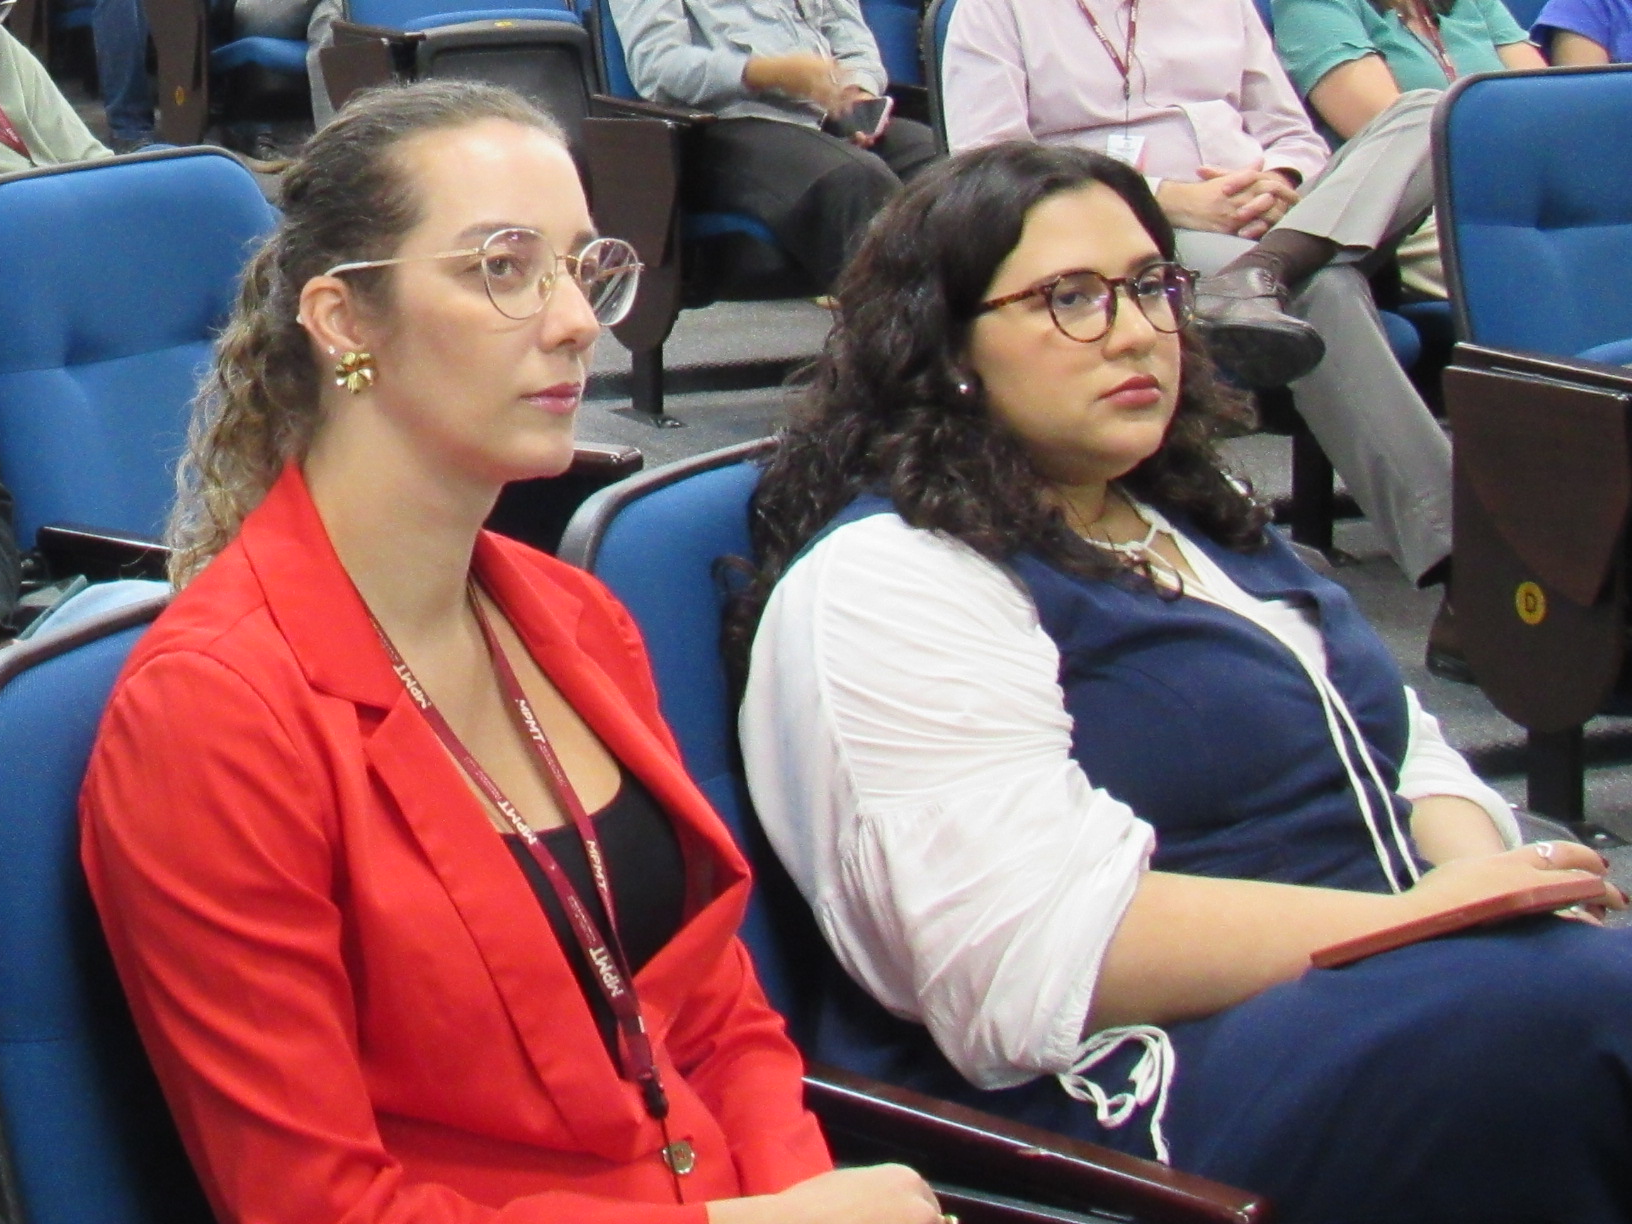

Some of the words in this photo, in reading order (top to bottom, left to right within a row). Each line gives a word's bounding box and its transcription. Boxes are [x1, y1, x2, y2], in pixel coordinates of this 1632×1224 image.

[393, 664, 432, 709] MPMT
[515, 699, 546, 743] MPMT
[497, 800, 538, 845] MPMT
[586, 840, 608, 892] MPMT
[589, 946, 625, 998] MPMT
